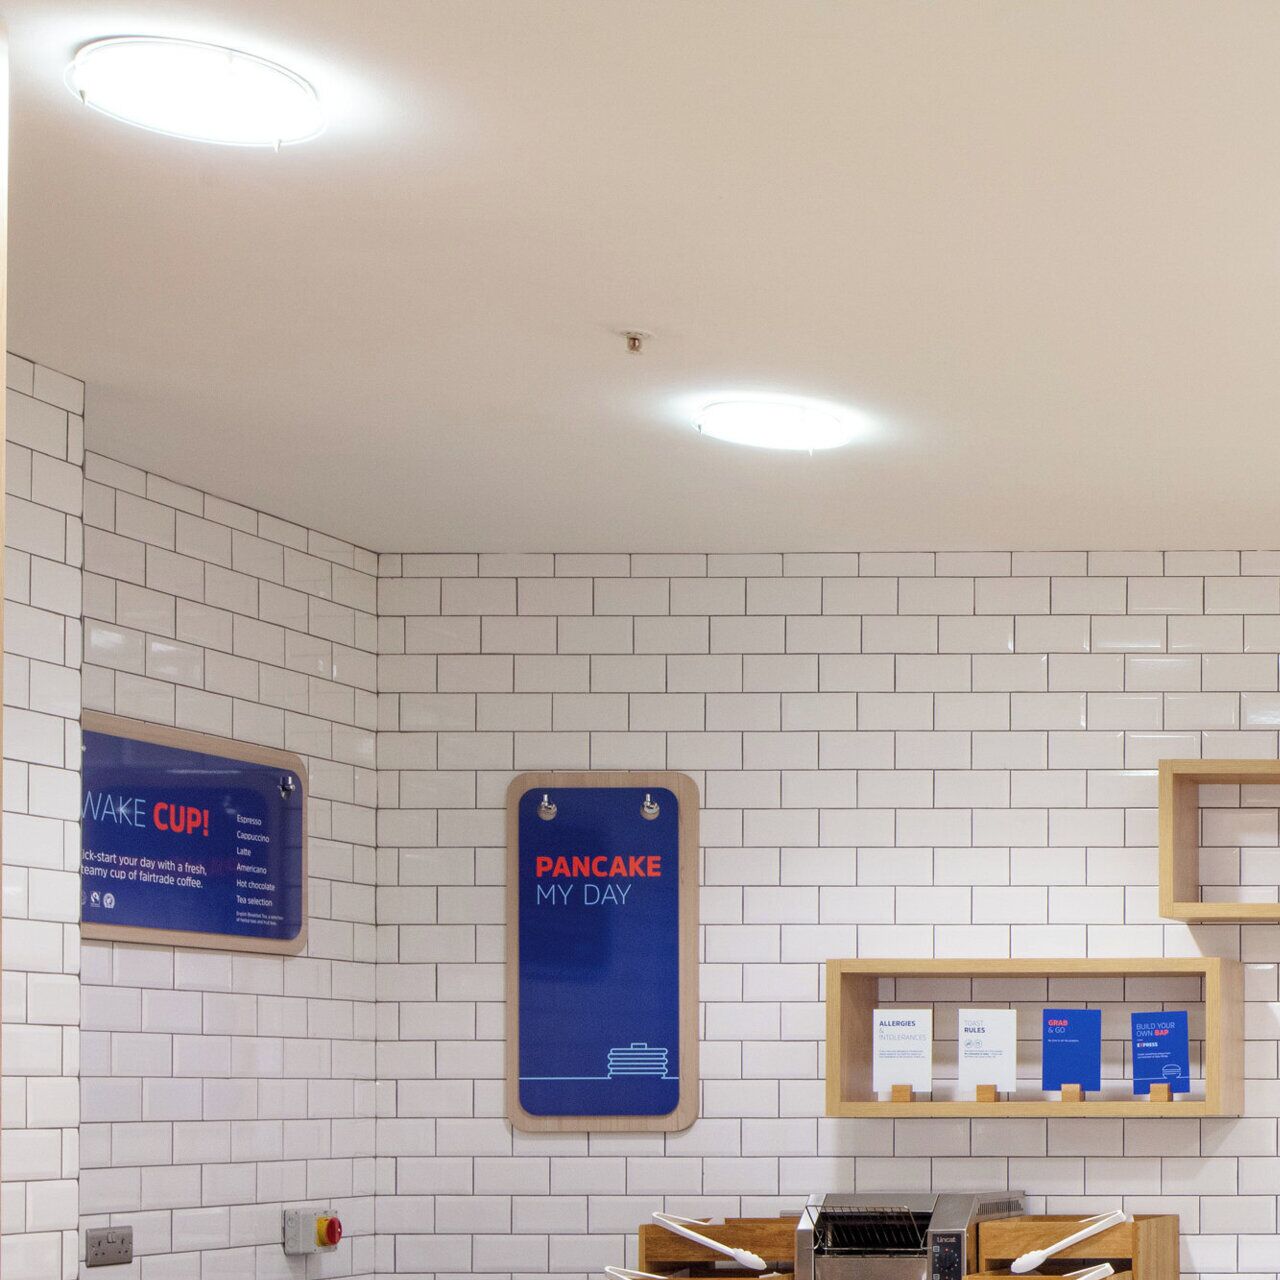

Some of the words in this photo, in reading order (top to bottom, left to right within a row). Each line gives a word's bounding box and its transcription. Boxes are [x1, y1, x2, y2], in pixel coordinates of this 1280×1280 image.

[82, 791, 146, 828] WAKE
[153, 802, 209, 837] CUP!
[236, 814, 262, 826] Espresso
[236, 830, 270, 843] Cappuccino
[236, 847, 252, 857] Latte
[81, 849, 117, 864] ick-start
[119, 855, 138, 866] your
[140, 857, 156, 870] day
[158, 861, 176, 872] with
[177, 864, 183, 872] a
[185, 862, 207, 876] fresh,
[236, 862, 267, 875] Americano
[536, 855, 662, 878] PANCAKE
[80, 864, 108, 879] teamy
[110, 869, 126, 880] cup
[128, 871, 137, 880] of
[139, 872, 175, 885] fairtrade
[177, 877, 203, 888] coffee.
[236, 879, 248, 888] Hot
[248, 881, 275, 892] chocolate
[236, 895, 247, 904] Tea
[248, 897, 273, 907] selection
[537, 884, 573, 905] MY
[584, 884, 632, 905] DAY
[1048, 1019, 1068, 1027] GRAB
[1157, 1021, 1176, 1029] YOUR
